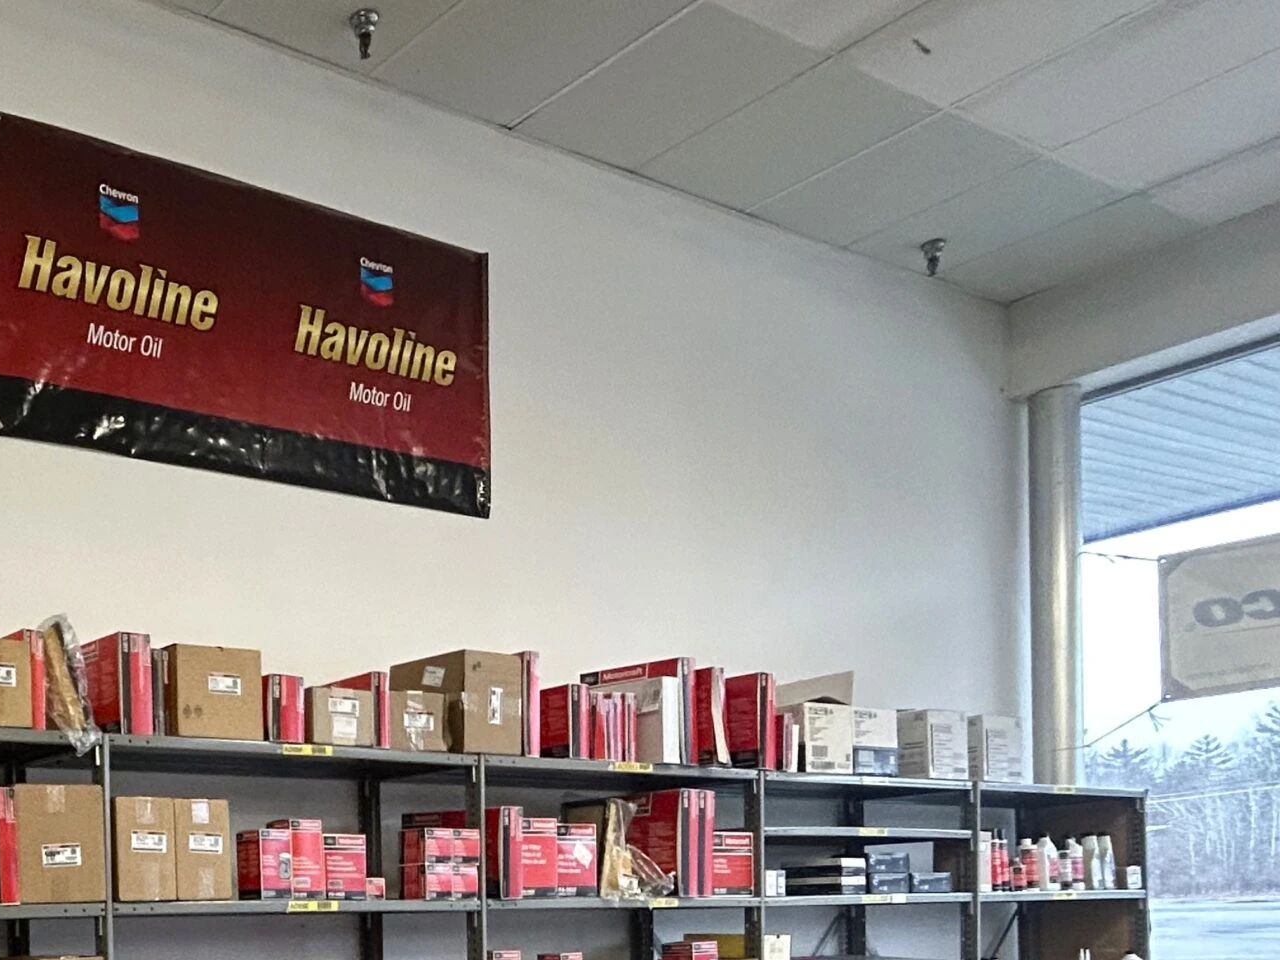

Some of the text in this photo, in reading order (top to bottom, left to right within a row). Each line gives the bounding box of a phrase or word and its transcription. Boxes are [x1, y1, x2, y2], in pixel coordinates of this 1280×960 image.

[99, 182, 139, 204] Chevron
[18, 233, 218, 331] Havoline
[359, 256, 393, 274] Chevron
[87, 322, 162, 359] Motor Oil
[293, 304, 458, 386] Havoline
[349, 381, 411, 412] Motor Oil
